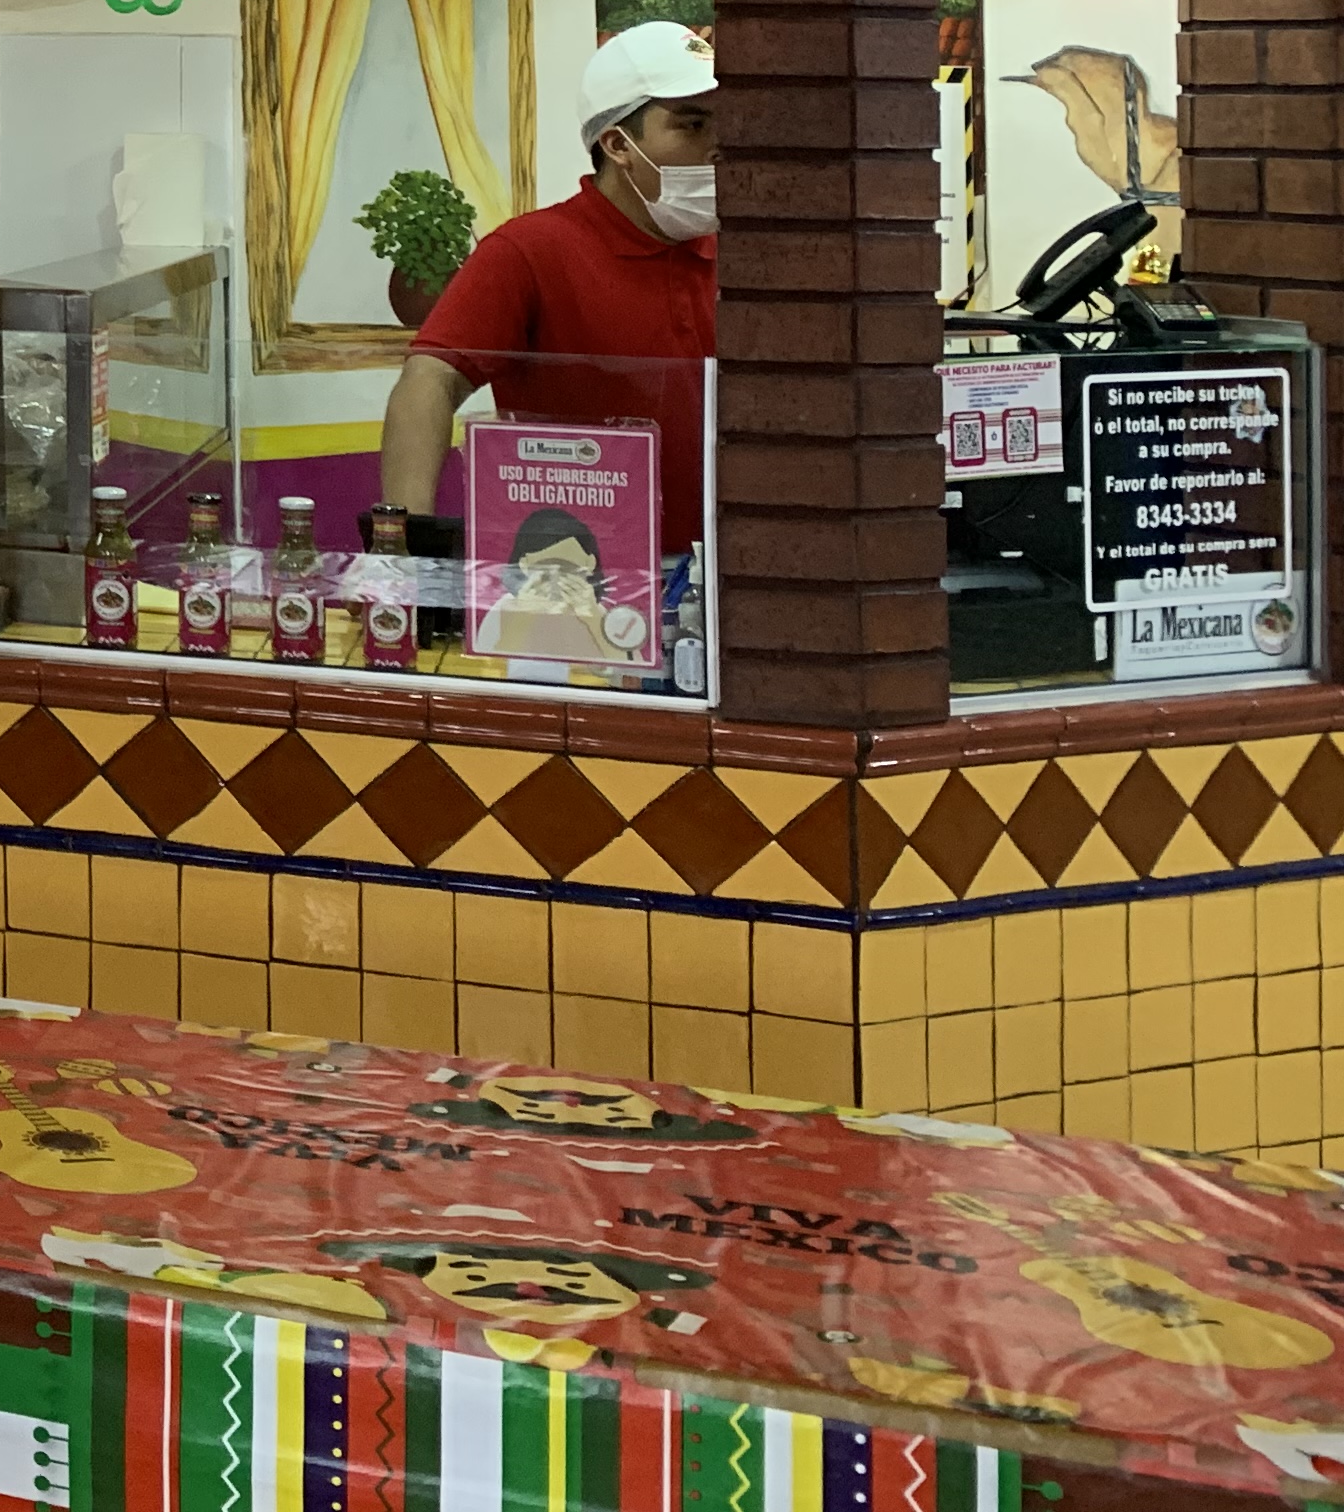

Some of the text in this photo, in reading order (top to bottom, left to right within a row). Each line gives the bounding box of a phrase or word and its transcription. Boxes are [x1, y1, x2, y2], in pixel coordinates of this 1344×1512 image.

[1126, 392, 1145, 405] no
[1148, 385, 1195, 405] recibe
[1198, 388, 1216, 402] su
[1219, 383, 1262, 402] ticket
[1107, 416, 1122, 433] el
[1125, 414, 1164, 436] total,
[1167, 418, 1186, 432] no
[1189, 412, 1279, 435] corresponde
[524, 440, 574, 456] La Mexicana
[1138, 441, 1232, 460] a su compra.
[499, 465, 629, 487] USO DE CUBREBOCAS
[1105, 467, 1266, 493] Favor de reportarlo al:
[508, 482, 616, 508] OBLIGATORIO
[1136, 500, 1237, 529] 8343-3334
[1096, 546, 1106, 559] Y
[1109, 545, 1122, 558] el
[1125, 543, 1157, 557] total
[1159, 541, 1176, 555] de
[1179, 541, 1195, 554] su
[1198, 538, 1246, 554] compra
[1144, 563, 1230, 590] GRATIS
[1131, 604, 1244, 643] La Mexicana
[684, 1193, 911, 1243] VIVA
[617, 1206, 979, 1276] MEXICO
